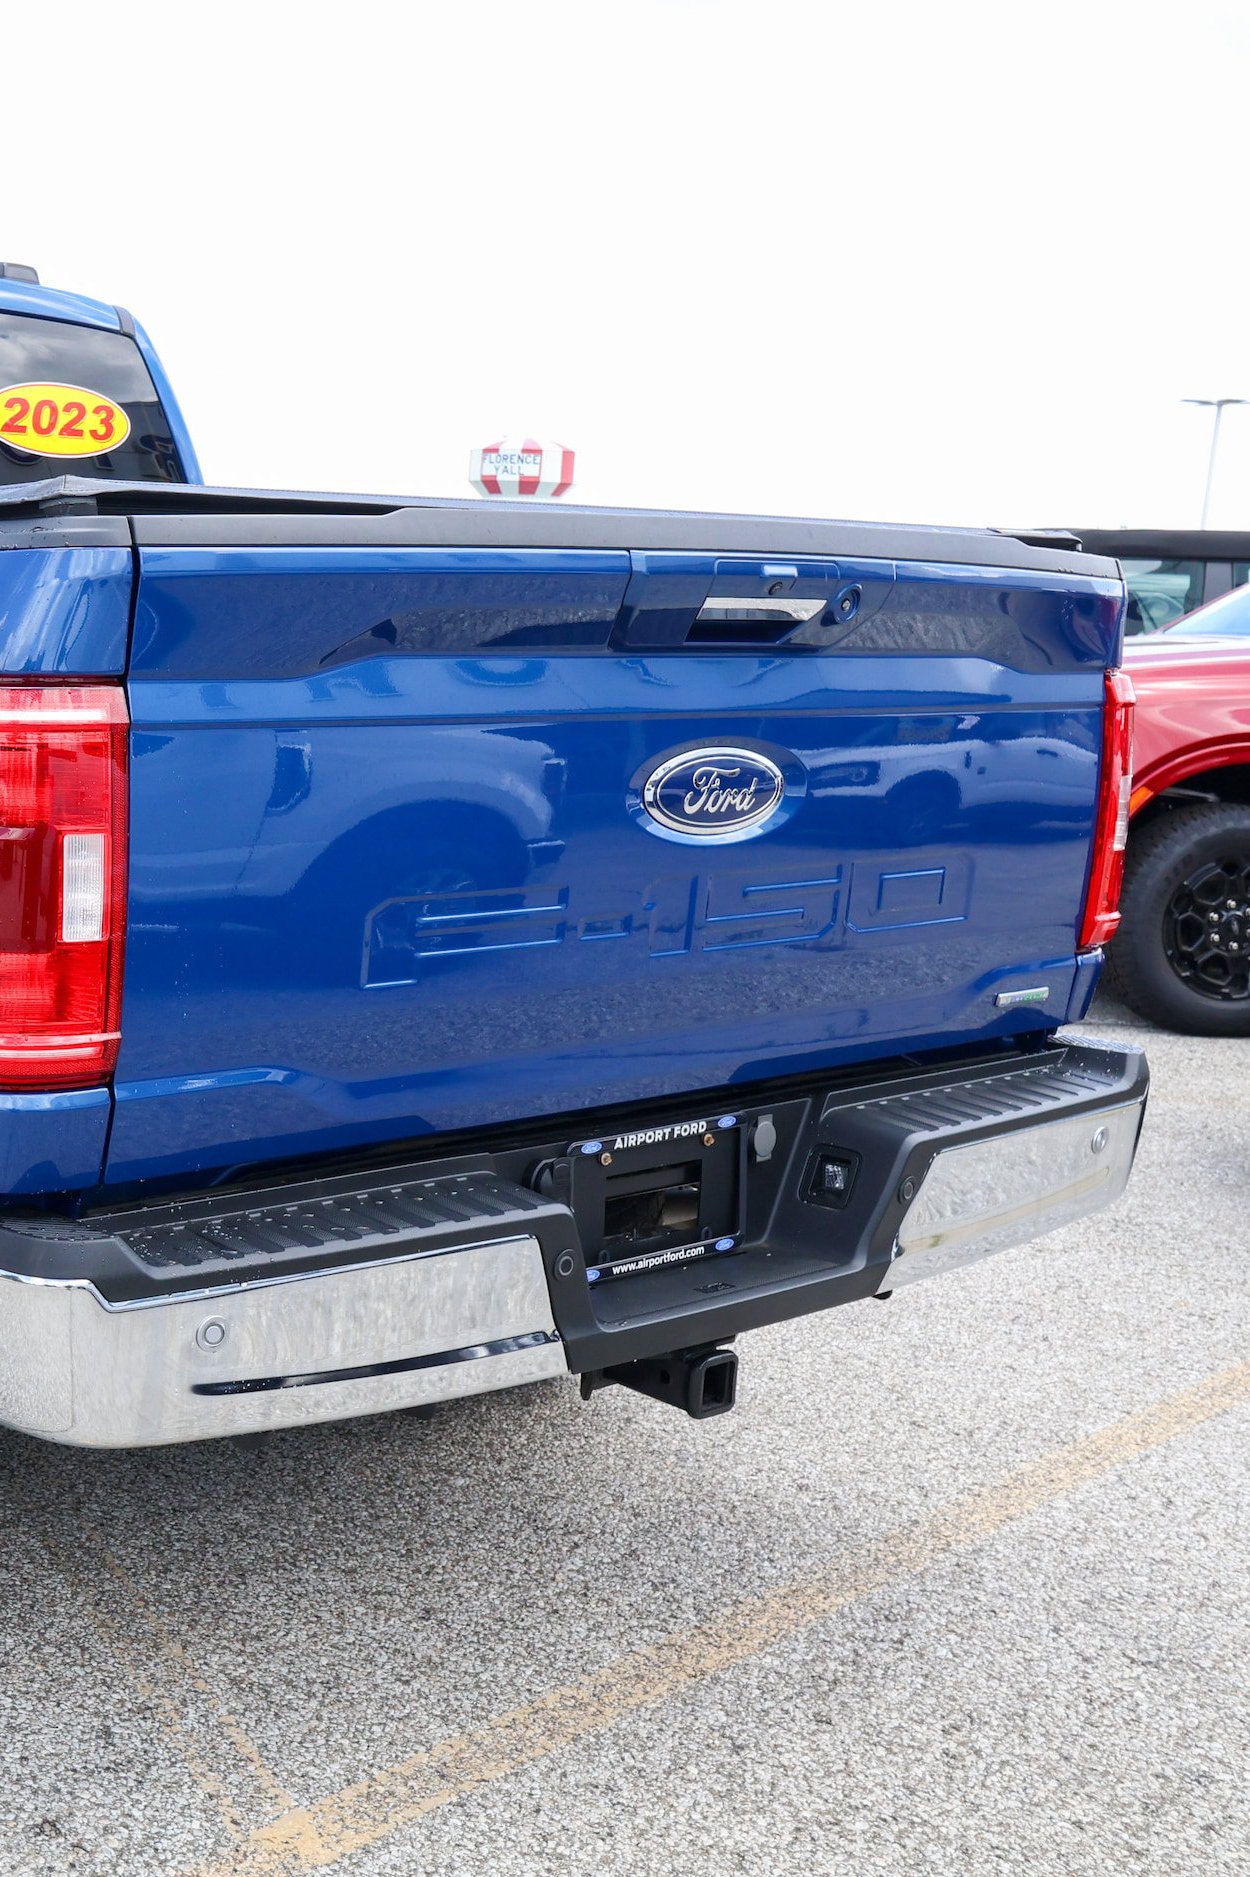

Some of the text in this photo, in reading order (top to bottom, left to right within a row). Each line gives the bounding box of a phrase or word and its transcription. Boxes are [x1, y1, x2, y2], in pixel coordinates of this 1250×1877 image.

[0, 397, 116, 441] 2023
[482, 453, 540, 465] FLORENCE
[684, 766, 758, 815] Ford
[360, 850, 972, 990] F-150
[613, 1120, 708, 1150] AIRPORT FORD
[612, 1245, 705, 1275] www.airportford.com
